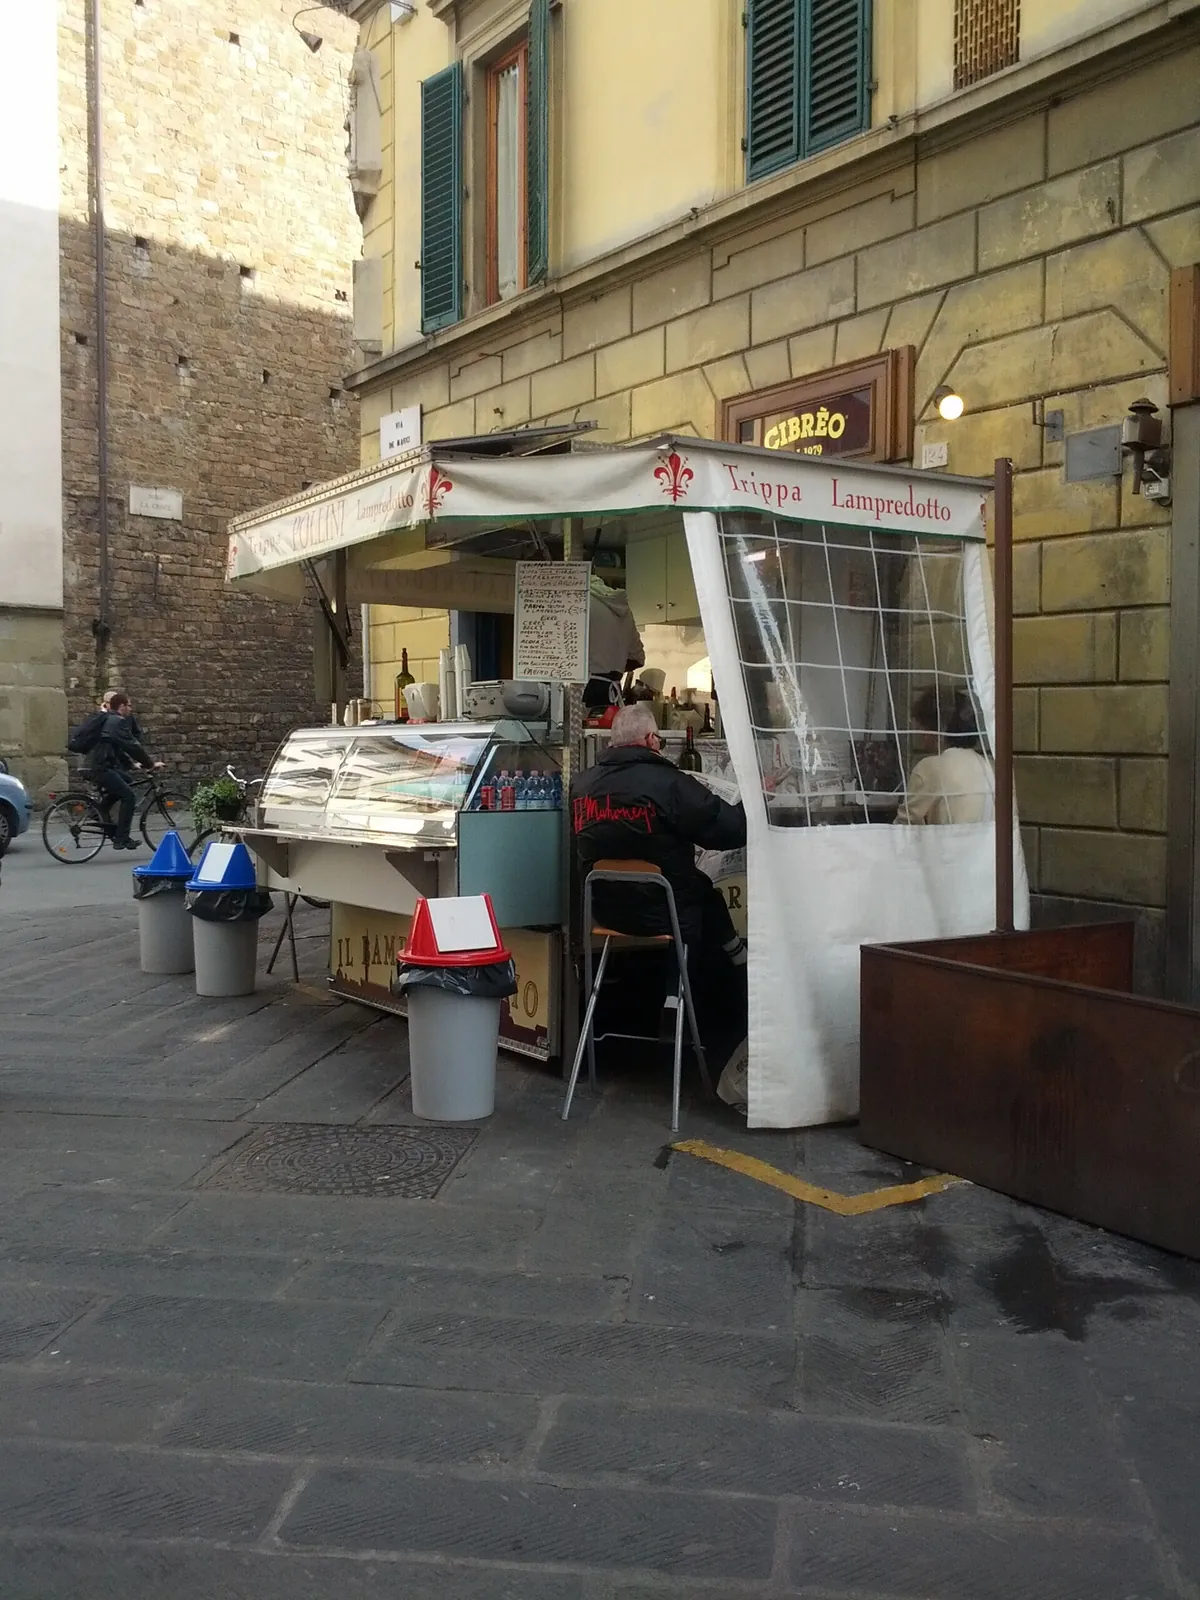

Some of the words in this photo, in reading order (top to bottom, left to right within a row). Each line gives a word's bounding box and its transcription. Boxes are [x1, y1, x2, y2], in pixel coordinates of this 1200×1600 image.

[764, 406, 845, 449] CIBRÈO
[292, 500, 345, 551] POLLINI
[356, 486, 414, 523] Lampredotto
[722, 463, 802, 507] Trippa
[831, 477, 951, 521] Lampredotto
